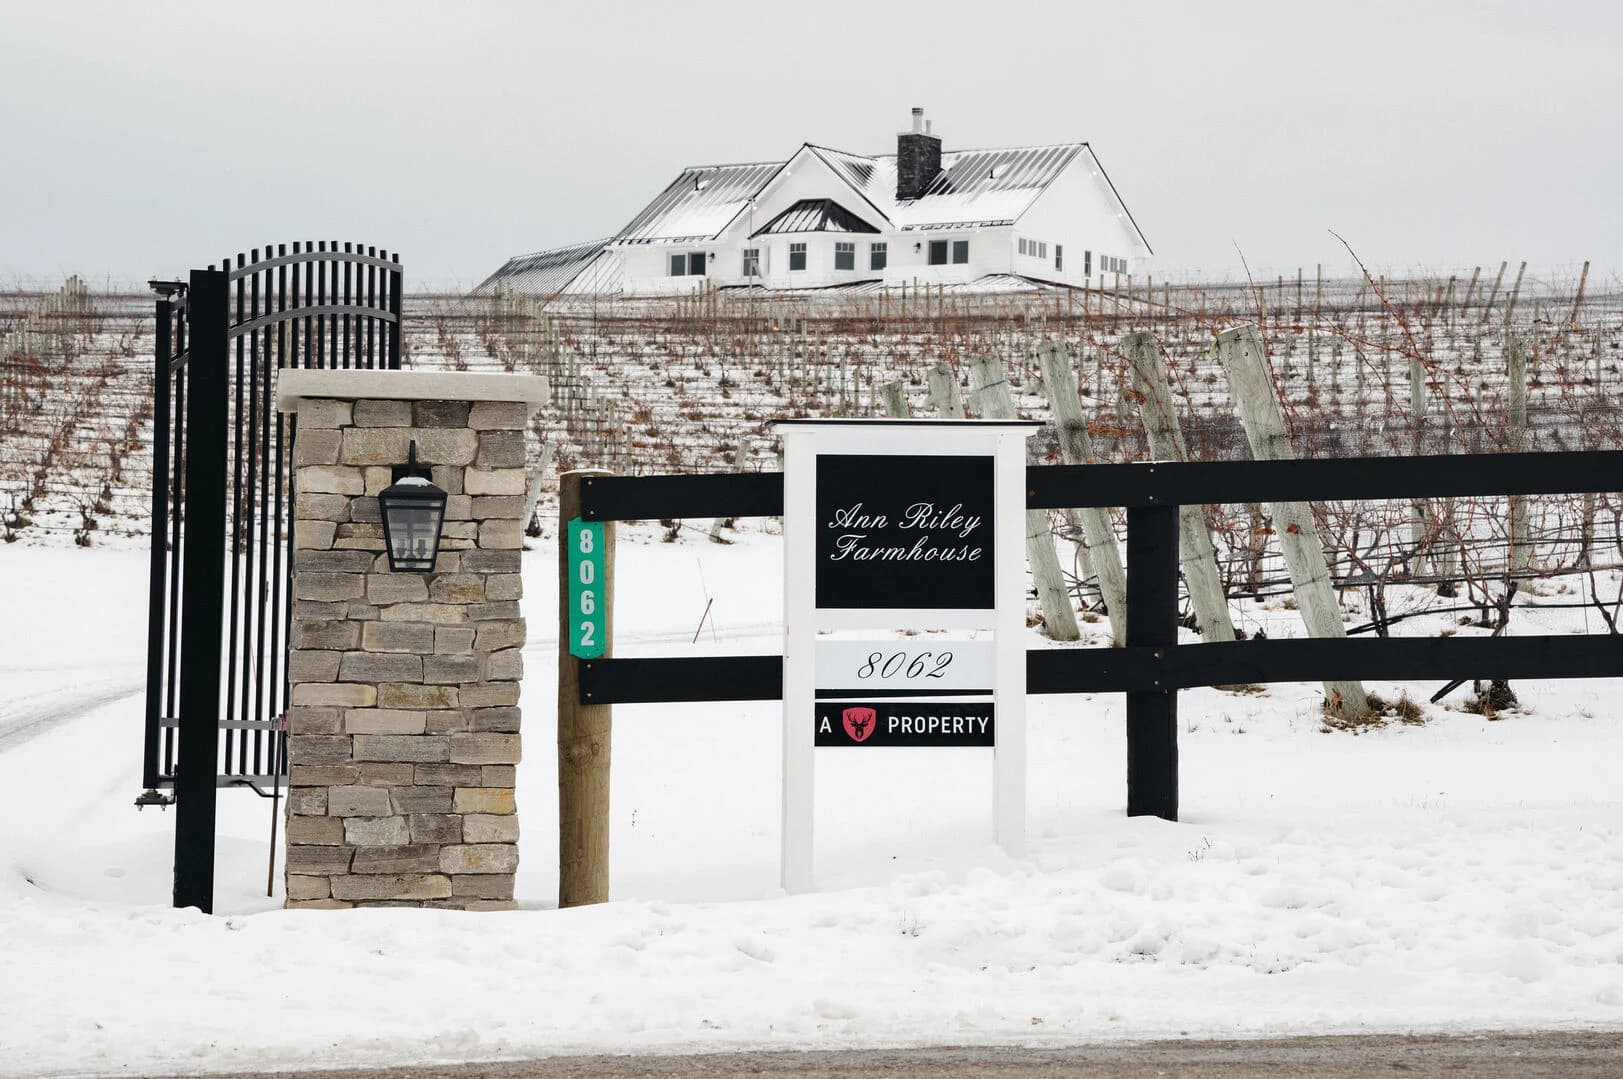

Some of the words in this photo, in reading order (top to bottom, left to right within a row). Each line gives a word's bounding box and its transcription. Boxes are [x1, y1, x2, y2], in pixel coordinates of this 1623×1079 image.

[828, 502, 888, 529] Ann
[898, 502, 981, 538] Riley
[830, 534, 982, 561] Farmhouse
[579, 529, 595, 646] 8062
[857, 651, 953, 679] 8062
[819, 716, 832, 733] A
[888, 716, 989, 733] PROPERTY
